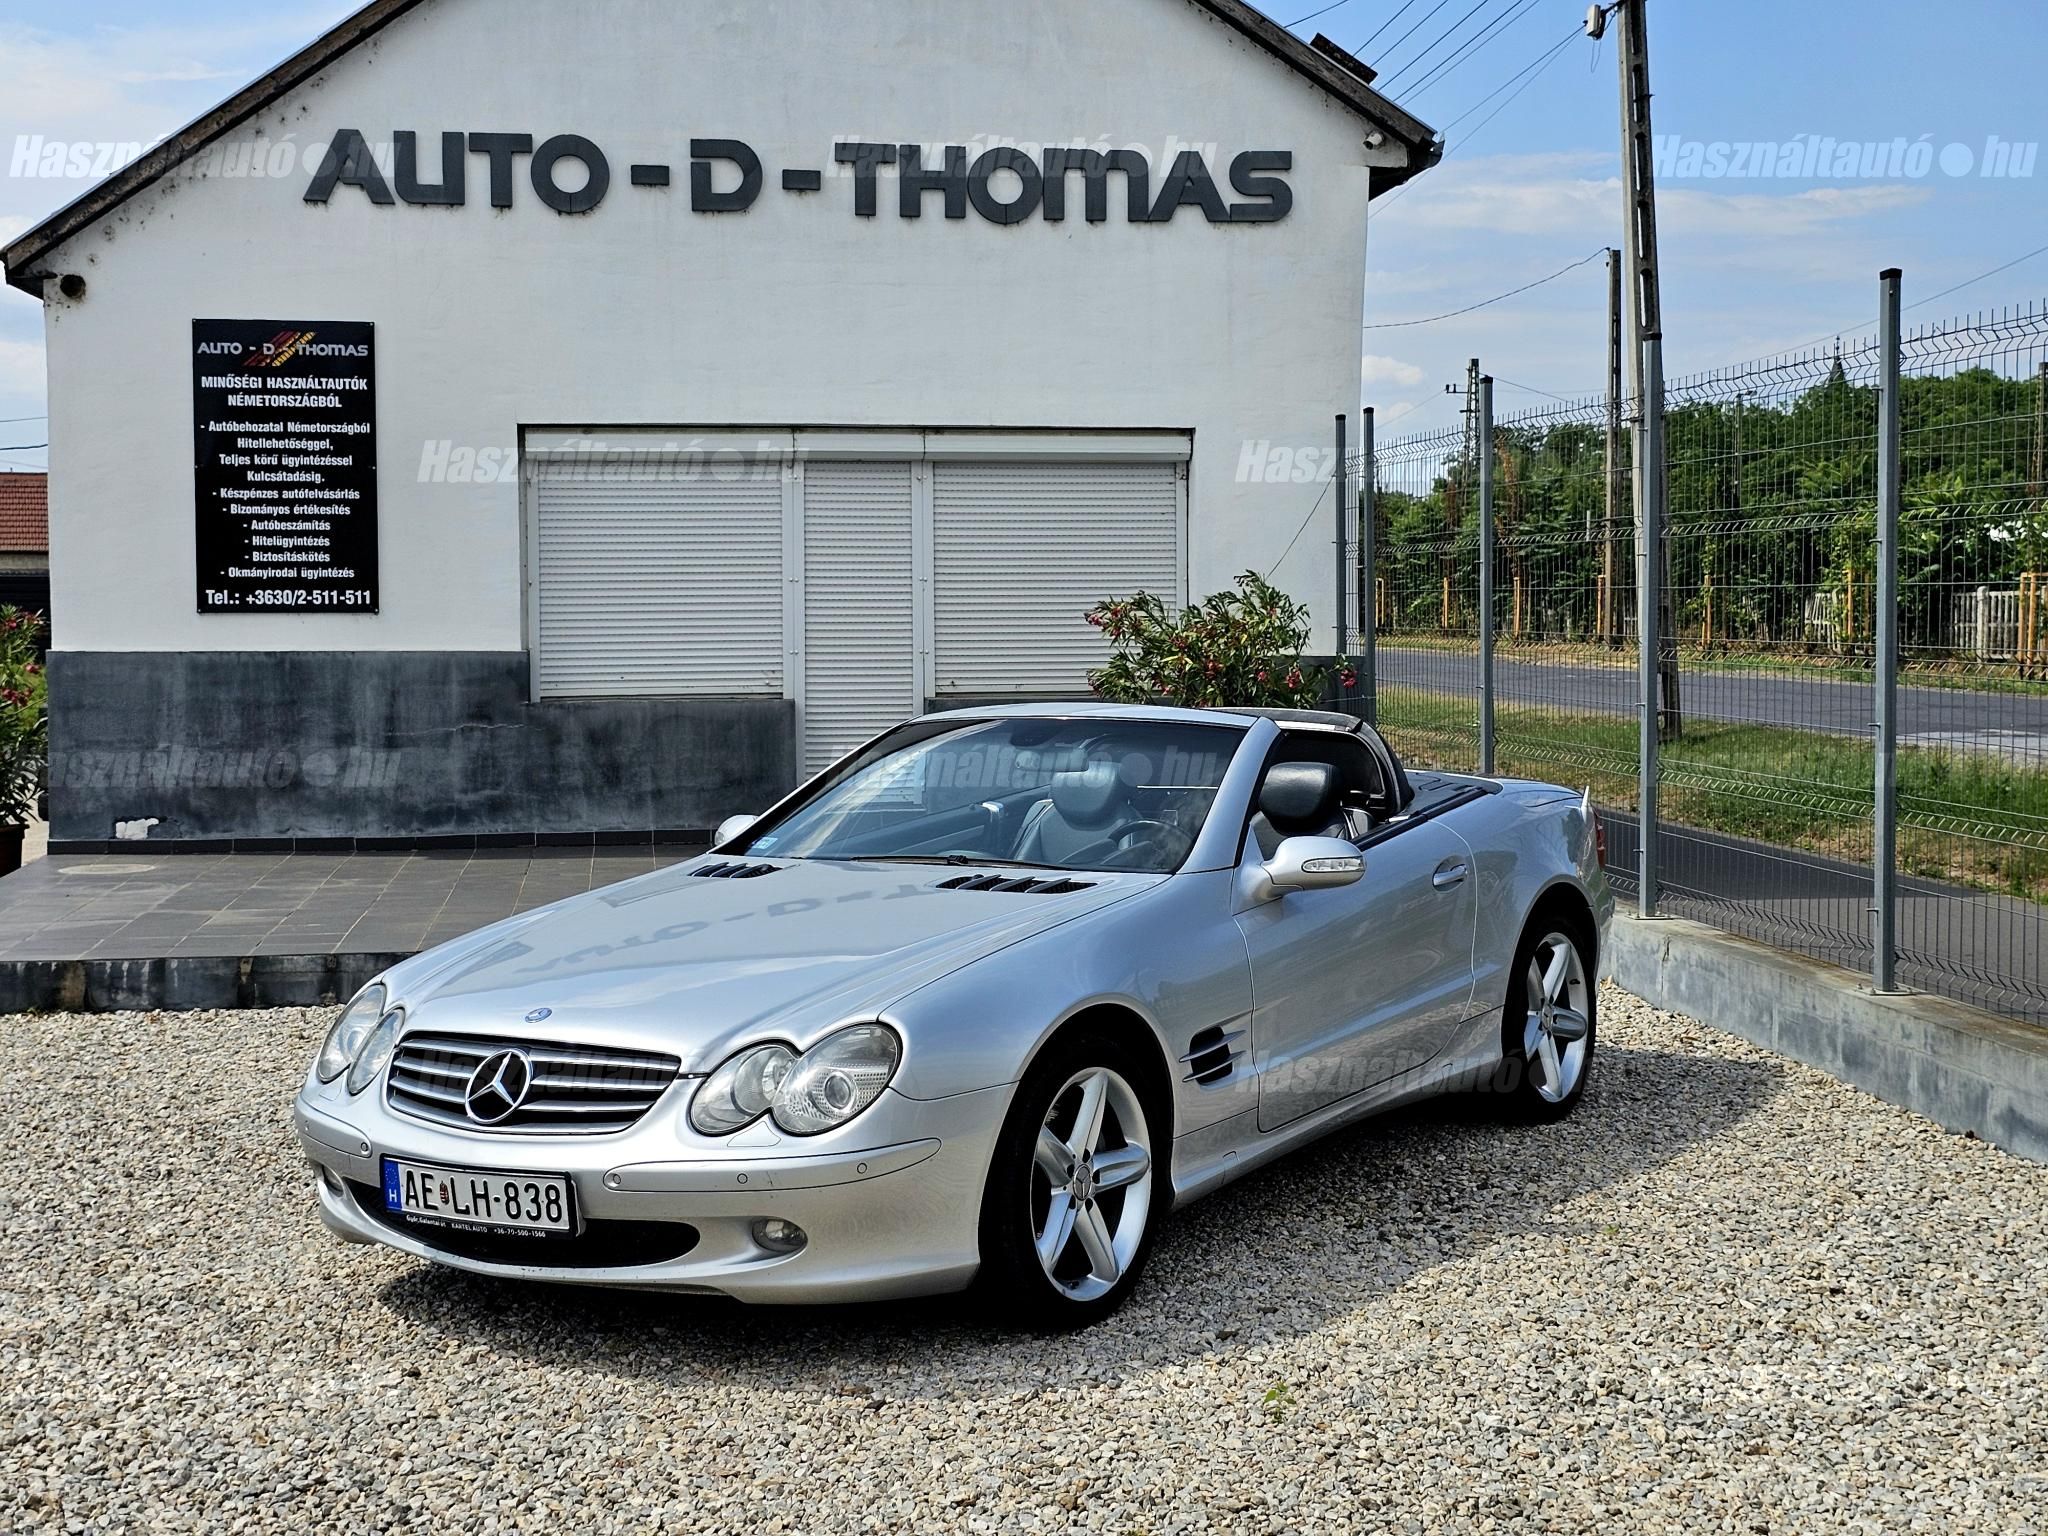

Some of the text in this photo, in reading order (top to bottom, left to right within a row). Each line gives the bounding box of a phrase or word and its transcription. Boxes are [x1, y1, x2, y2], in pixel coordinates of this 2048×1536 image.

[303, 128, 609, 214] AUTO
[834, 142, 1294, 225] THOMAS
[197, 342, 242, 355] AUTO
[262, 342, 275, 355] D
[295, 342, 369, 357] THOMAS
[201, 374, 368, 390] MINŐSÉGI HASZNÁLTAUTÓK
[227, 392, 343, 408] NÉMETORSZÁGBÓL
[208, 420, 284, 433] Autóbehozatal
[287, 421, 371, 435] Németországból
[237, 437, 334, 451] Hitellehetőséggel,
[219, 453, 353, 468] Teljes körű ügyintézéssel
[247, 470, 325, 484] Kulcsátadásig.
[220, 487, 279, 501] Készpénzes
[282, 488, 360, 500] autófelvásárlás
[230, 503, 291, 517] Bizományos
[293, 504, 351, 515] értékesítés
[251, 519, 331, 531] Autóbeszámítás
[252, 535, 331, 548] Hitelügyintézés
[252, 551, 331, 562] Biztosításkötés
[228, 566, 298, 580] Okmányirodai
[300, 567, 355, 580] ügyintézés
[206, 589, 371, 606] Tel.: +3630/2-511-511
[388, 1188, 398, 1203] H
[472, 1225, 488, 1233] AUTO
